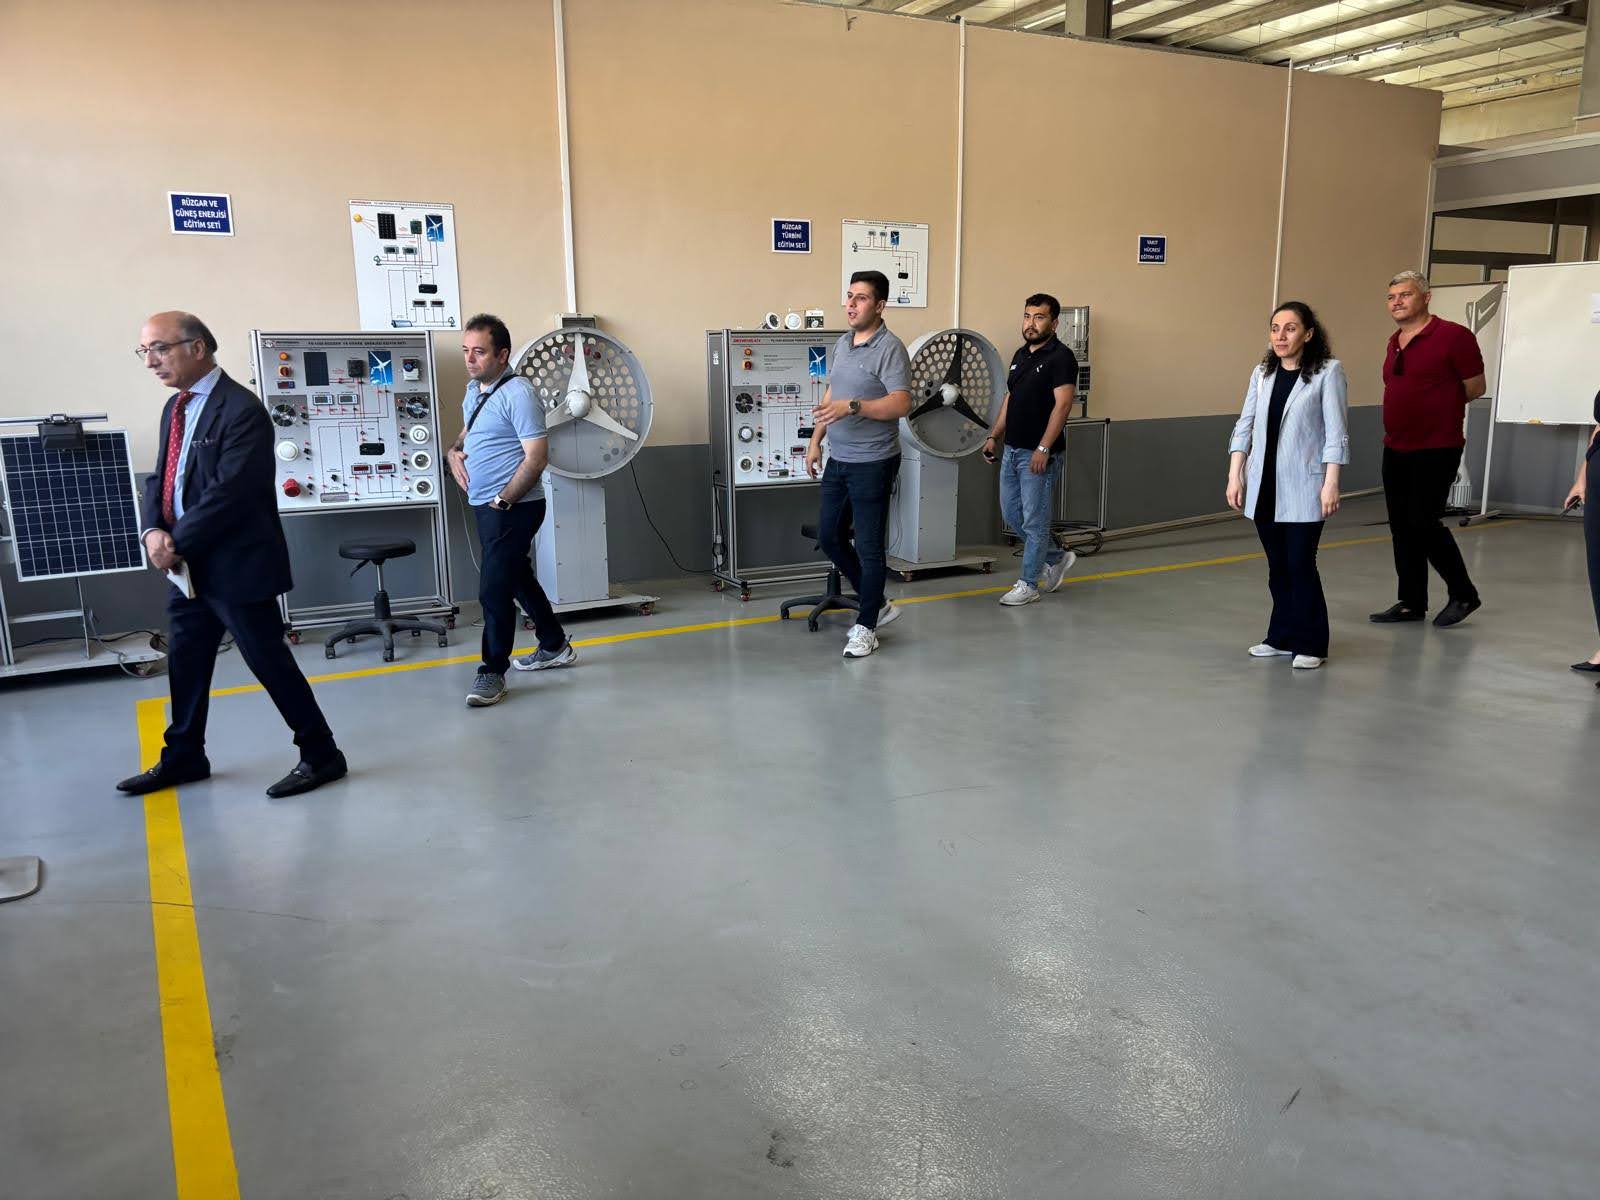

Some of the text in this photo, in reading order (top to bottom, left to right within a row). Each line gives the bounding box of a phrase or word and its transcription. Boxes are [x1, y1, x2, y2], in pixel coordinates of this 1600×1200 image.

[181, 198, 208, 207] RÜZGAR
[175, 208, 227, 219] GÜNEŞ ENERJİSİ
[184, 219, 221, 229] EĞİTİM SETİ
